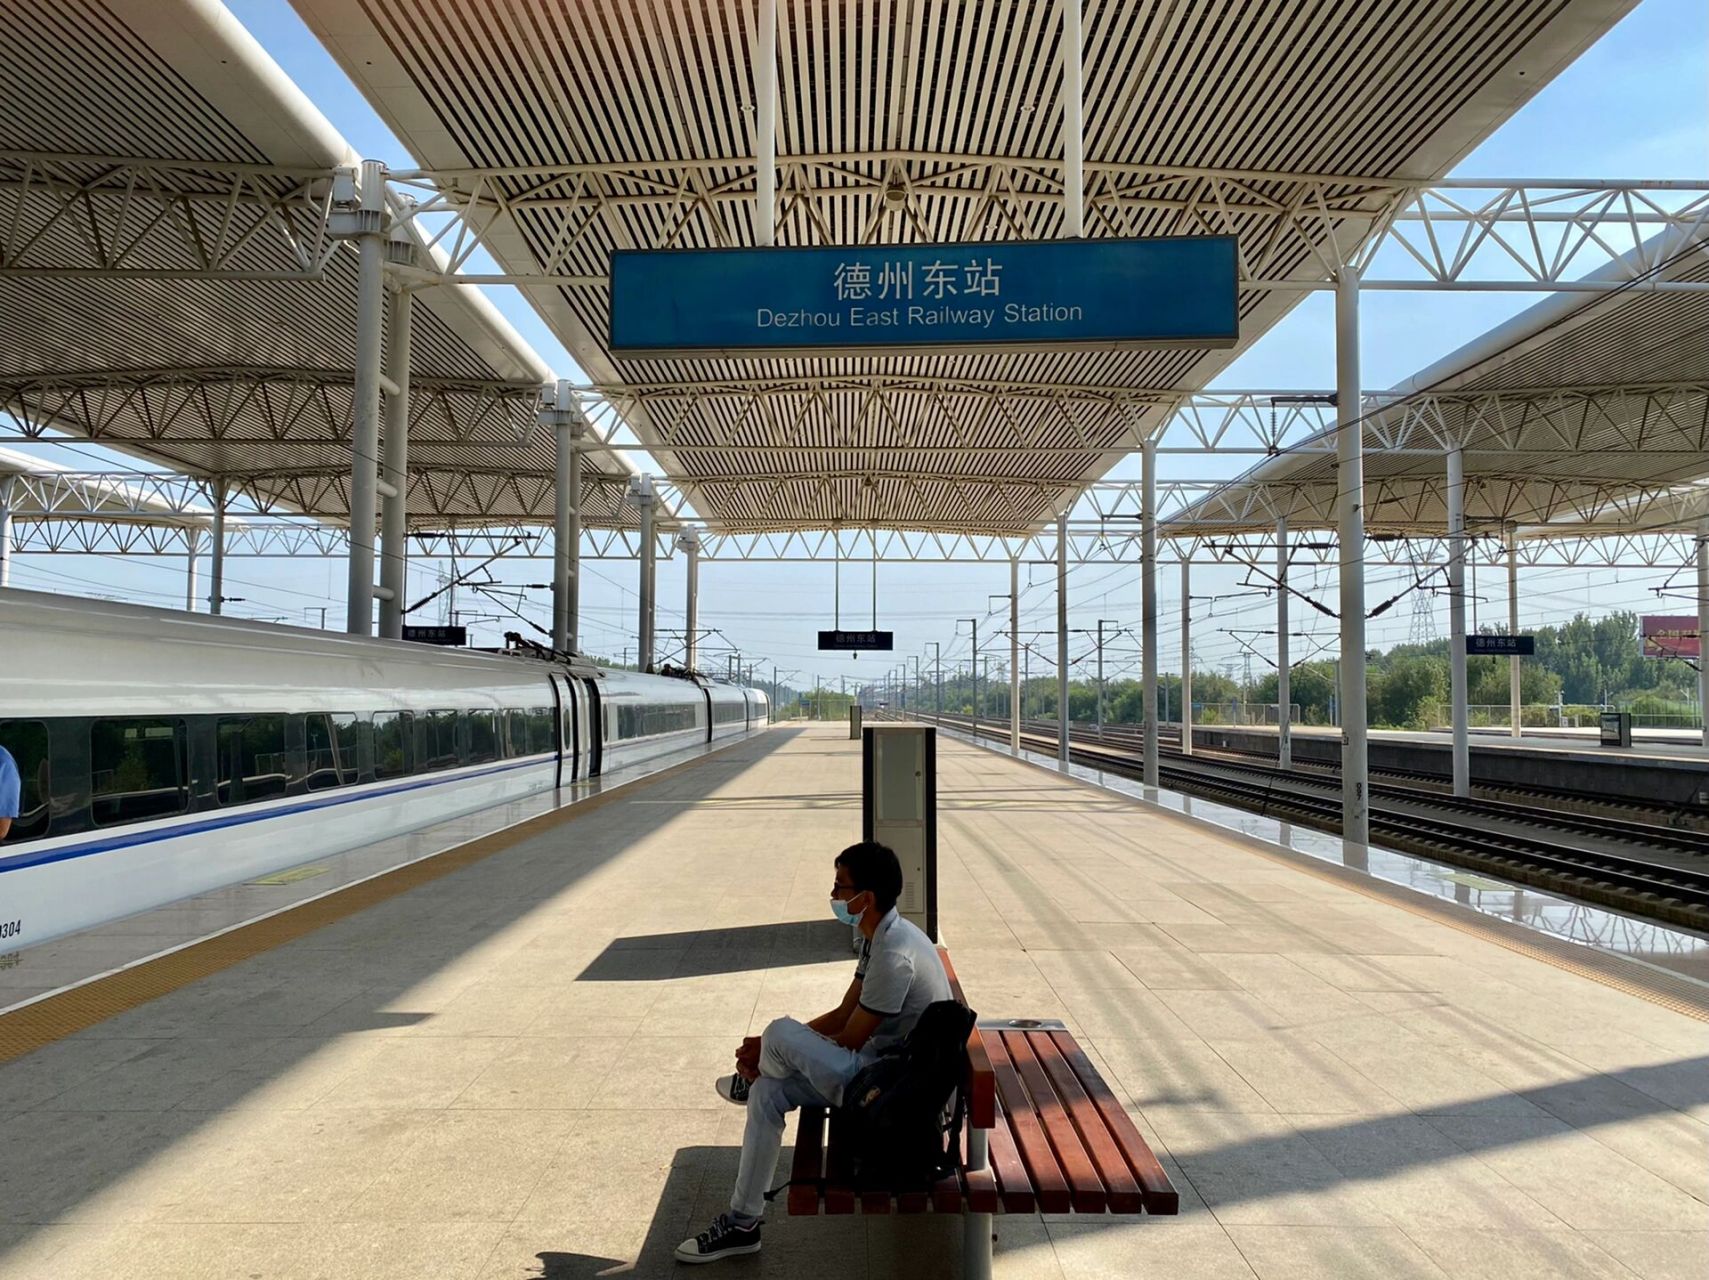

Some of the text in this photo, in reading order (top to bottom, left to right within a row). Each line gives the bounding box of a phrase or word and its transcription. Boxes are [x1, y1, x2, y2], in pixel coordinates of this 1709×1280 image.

[833, 258, 1003, 300] 德州东站
[757, 302, 1082, 328] Dezhou East Railway Station
[1475, 637, 1517, 648] 德州东站
